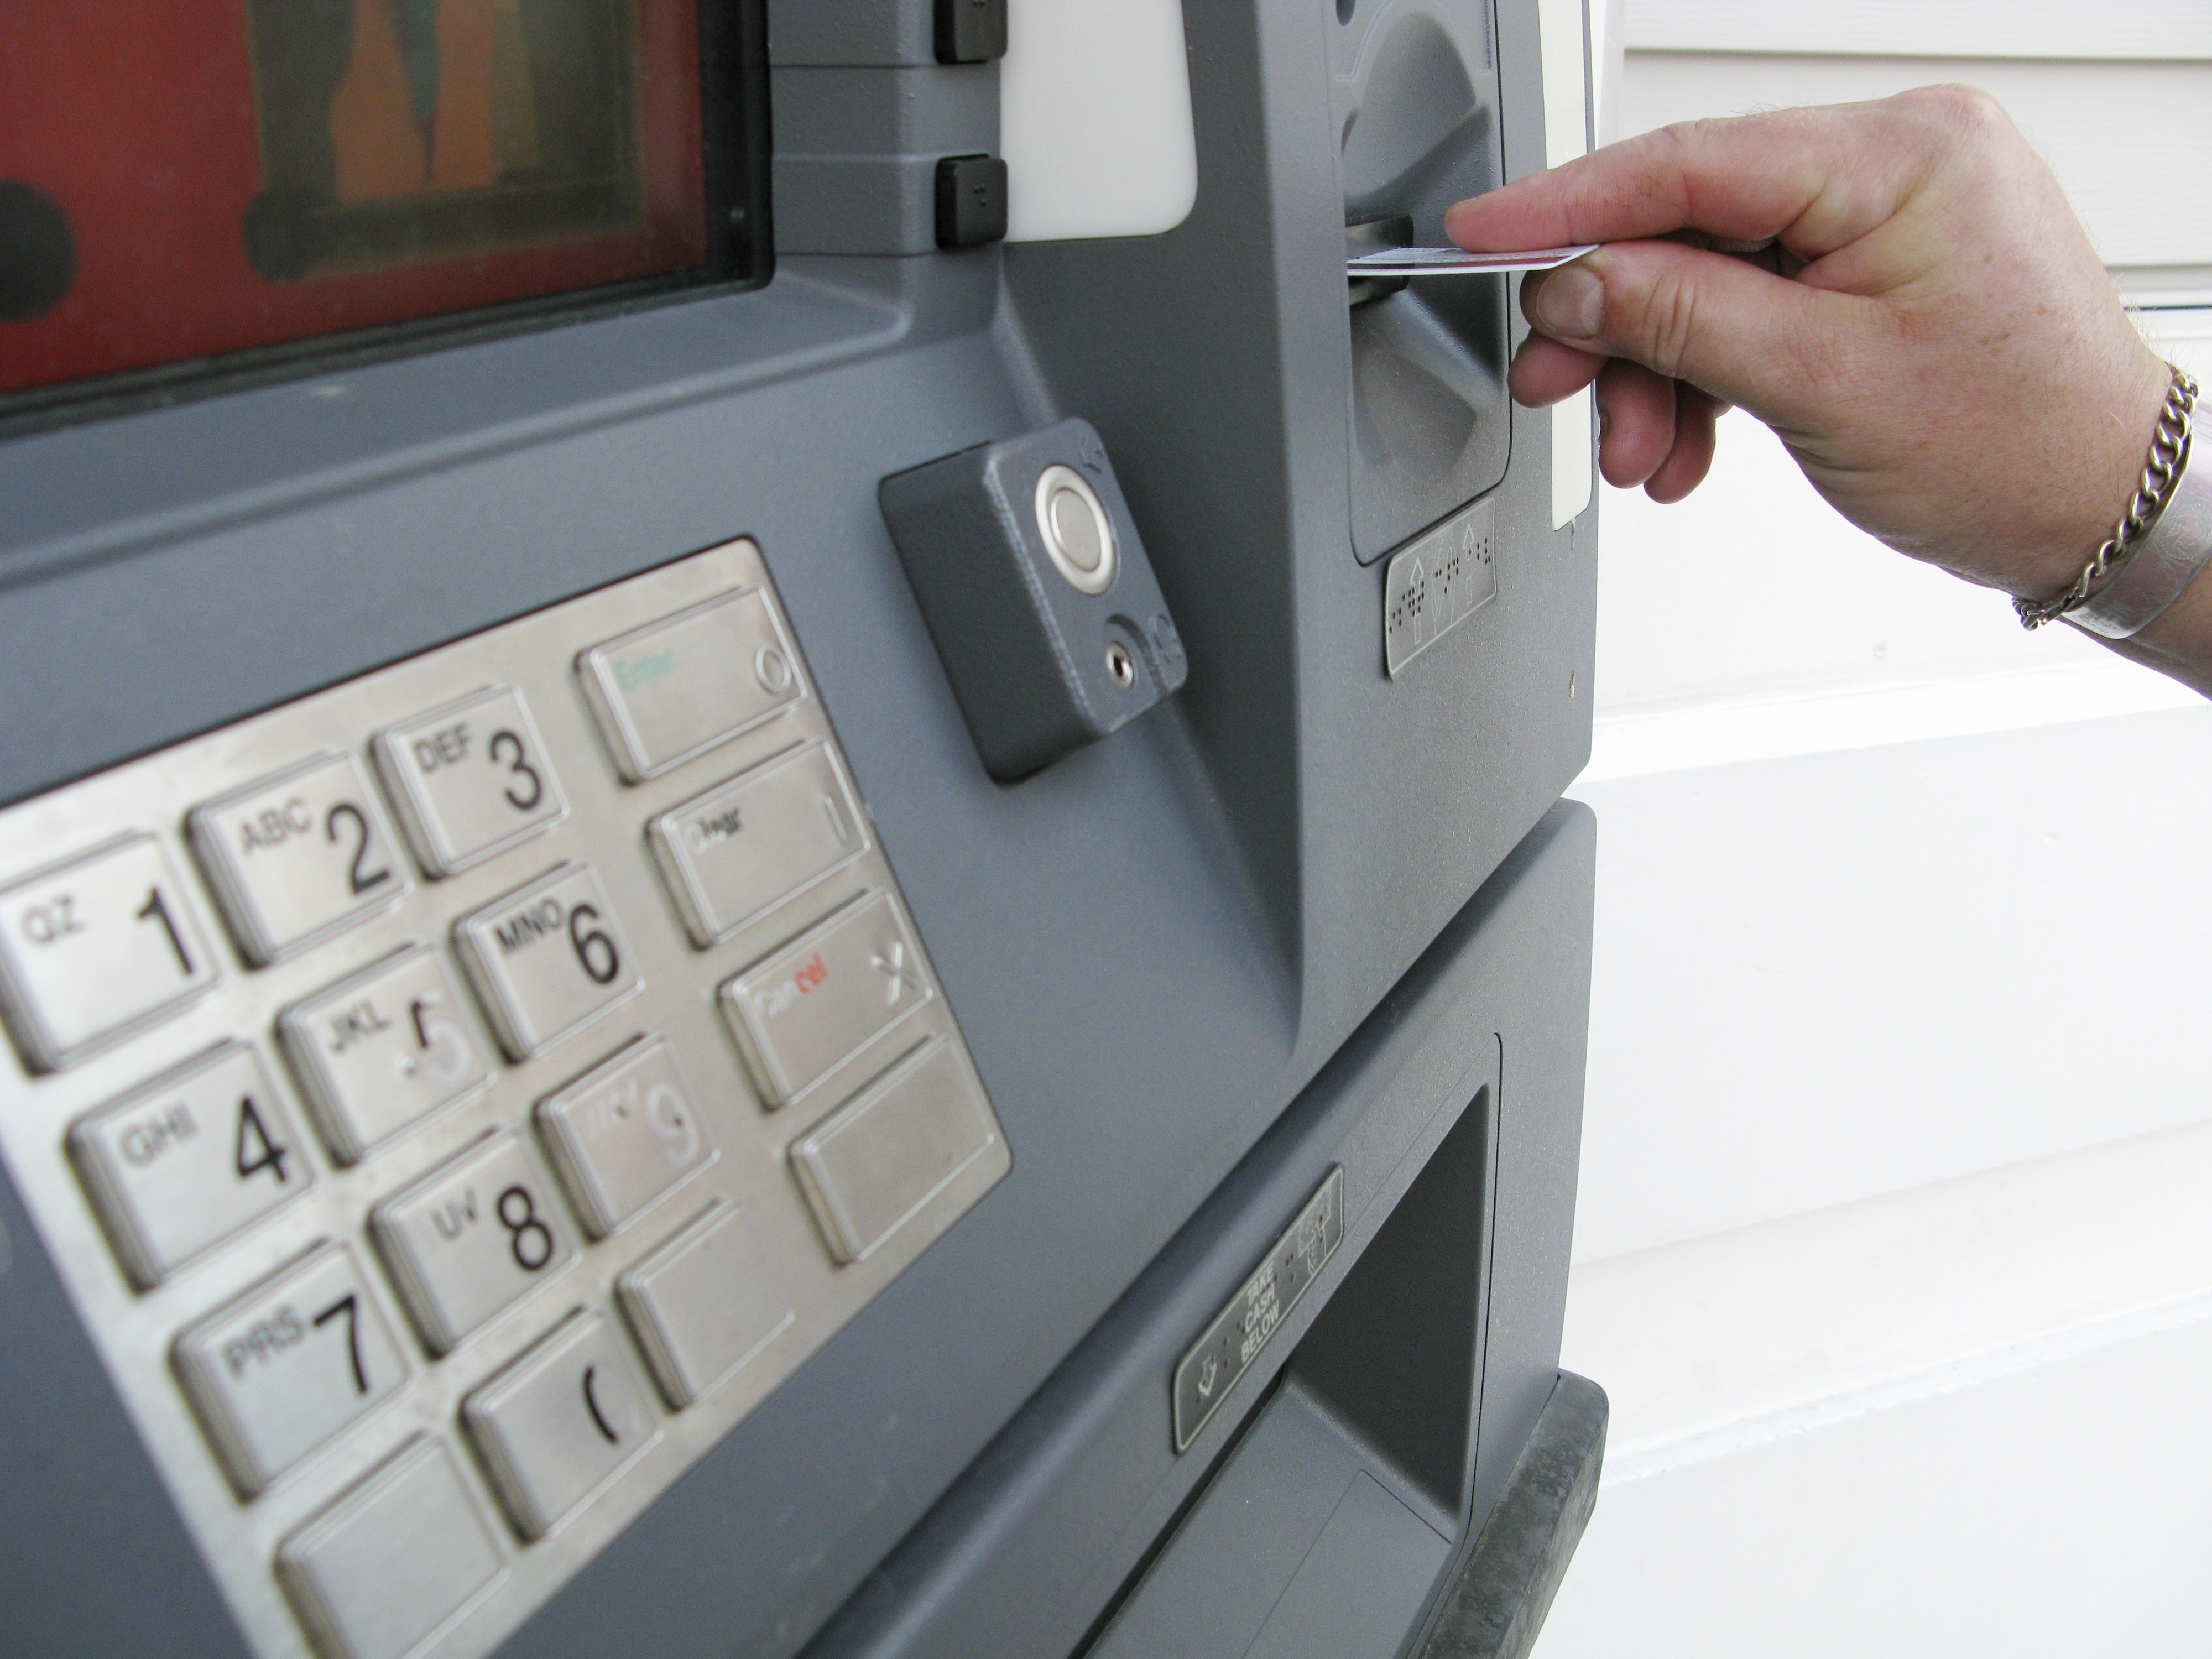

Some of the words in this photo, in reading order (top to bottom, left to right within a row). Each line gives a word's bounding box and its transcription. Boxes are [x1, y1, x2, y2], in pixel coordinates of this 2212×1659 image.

[413, 723, 473, 775] DEF
[488, 728, 541, 811] 3
[240, 796, 314, 856] ABC
[326, 802, 390, 895] 2
[22, 891, 85, 946] QZ
[137, 886, 194, 975] 1
[494, 898, 565, 954] MNO
[568, 904, 619, 985] 6
[331, 997, 392, 1053] JKL
[118, 1103, 200, 1168] GHI
[234, 1097, 288, 1183] 4
[497, 1185, 554, 1272] 8
[1245, 1281, 1275, 1333] CASH
[1247, 1260, 1274, 1306] TAKE
[225, 1303, 306, 1382] PRS
[313, 1294, 368, 1395] 7
[1241, 1298, 1280, 1364] BELOW
